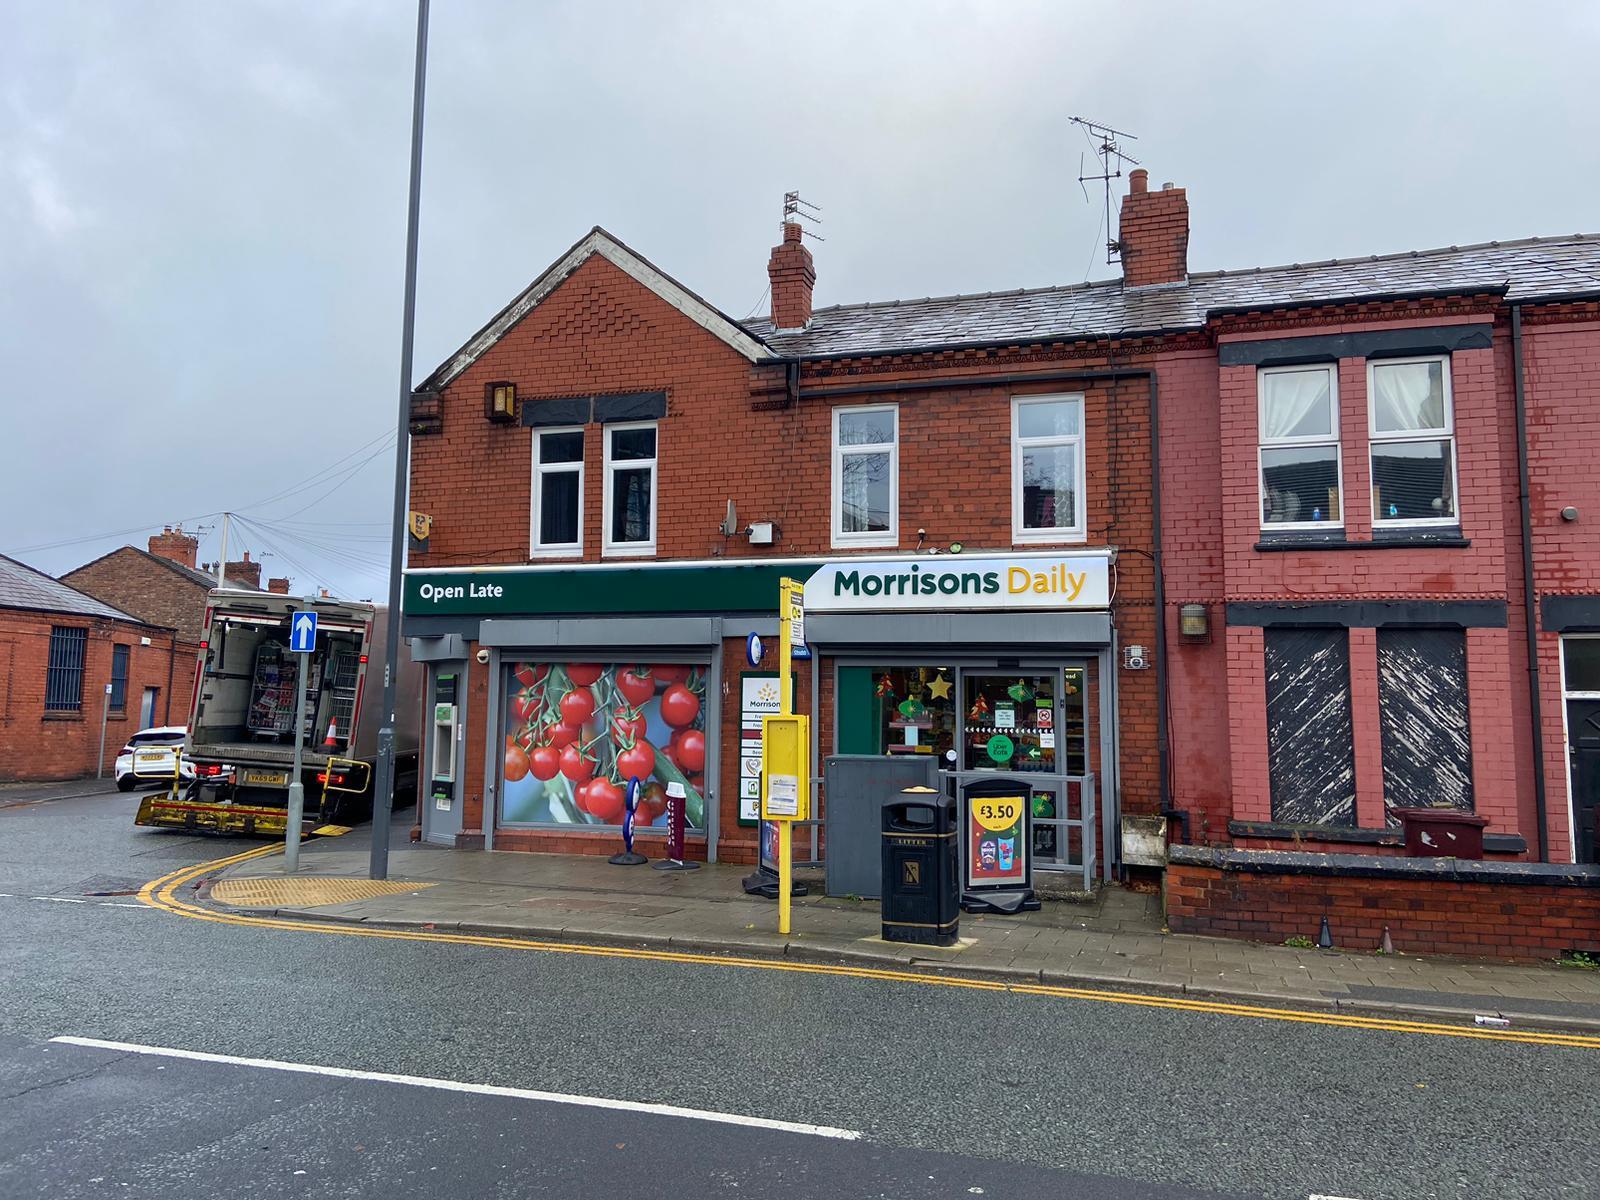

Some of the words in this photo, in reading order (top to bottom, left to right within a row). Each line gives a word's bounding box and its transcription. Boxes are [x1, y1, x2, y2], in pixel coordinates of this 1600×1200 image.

[834, 564, 1000, 596] Morrisons
[1008, 563, 1087, 601] Daily
[419, 583, 464, 603] Open
[469, 583, 503, 598] Late
[980, 805, 1014, 819] £3.50
